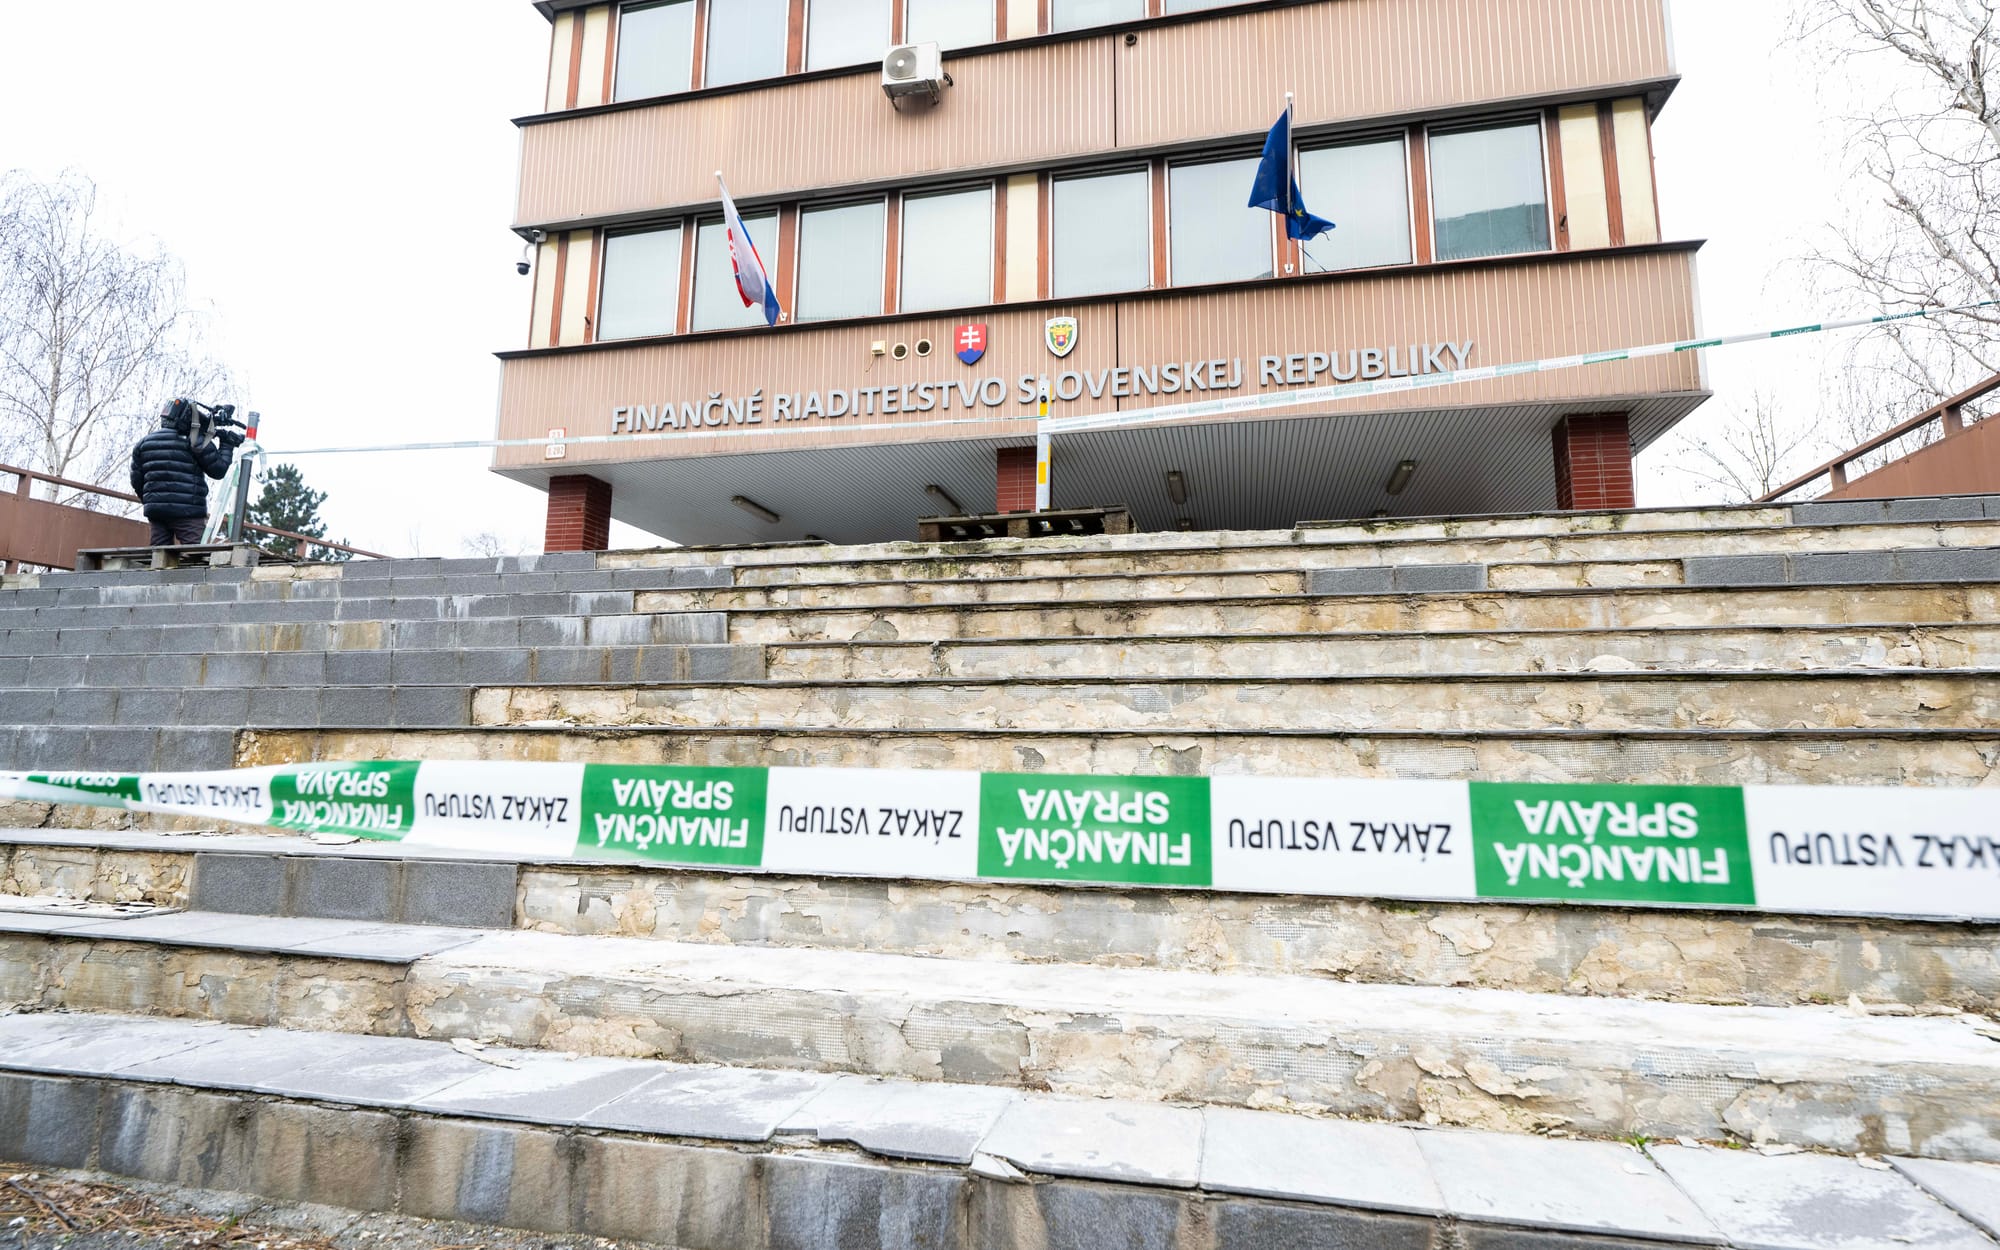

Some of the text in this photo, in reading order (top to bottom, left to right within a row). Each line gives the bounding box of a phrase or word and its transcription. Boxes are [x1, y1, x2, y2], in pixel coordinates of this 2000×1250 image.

[611, 339, 1473, 433] FINANČNÉ RIADITEĽSTVO SOVENSKEJ REPUBLIKY
[148, 783, 205, 806] VSTUPU
[208, 786, 262, 812] ZÁKAZ
[296, 771, 391, 801] SPRÁVA
[612, 778, 734, 815] SPRÁVA
[284, 800, 403, 829] FINANČNÁ
[425, 793, 568, 829] ZÁKAZ VSTUPU
[779, 805, 963, 846] ZÁKAZ VSTUPU
[1017, 788, 1170, 829] SPRÁVA
[1515, 800, 1699, 845] SPRÁVA
[595, 812, 749, 850] FINANČNÁ
[997, 826, 1191, 868] FINANČNÁ
[1229, 818, 1452, 862] ZÁKAZ VSTUPU
[1770, 831, 1904, 866] VSTUPU
[1493, 842, 1730, 888] FINANČNÁ
